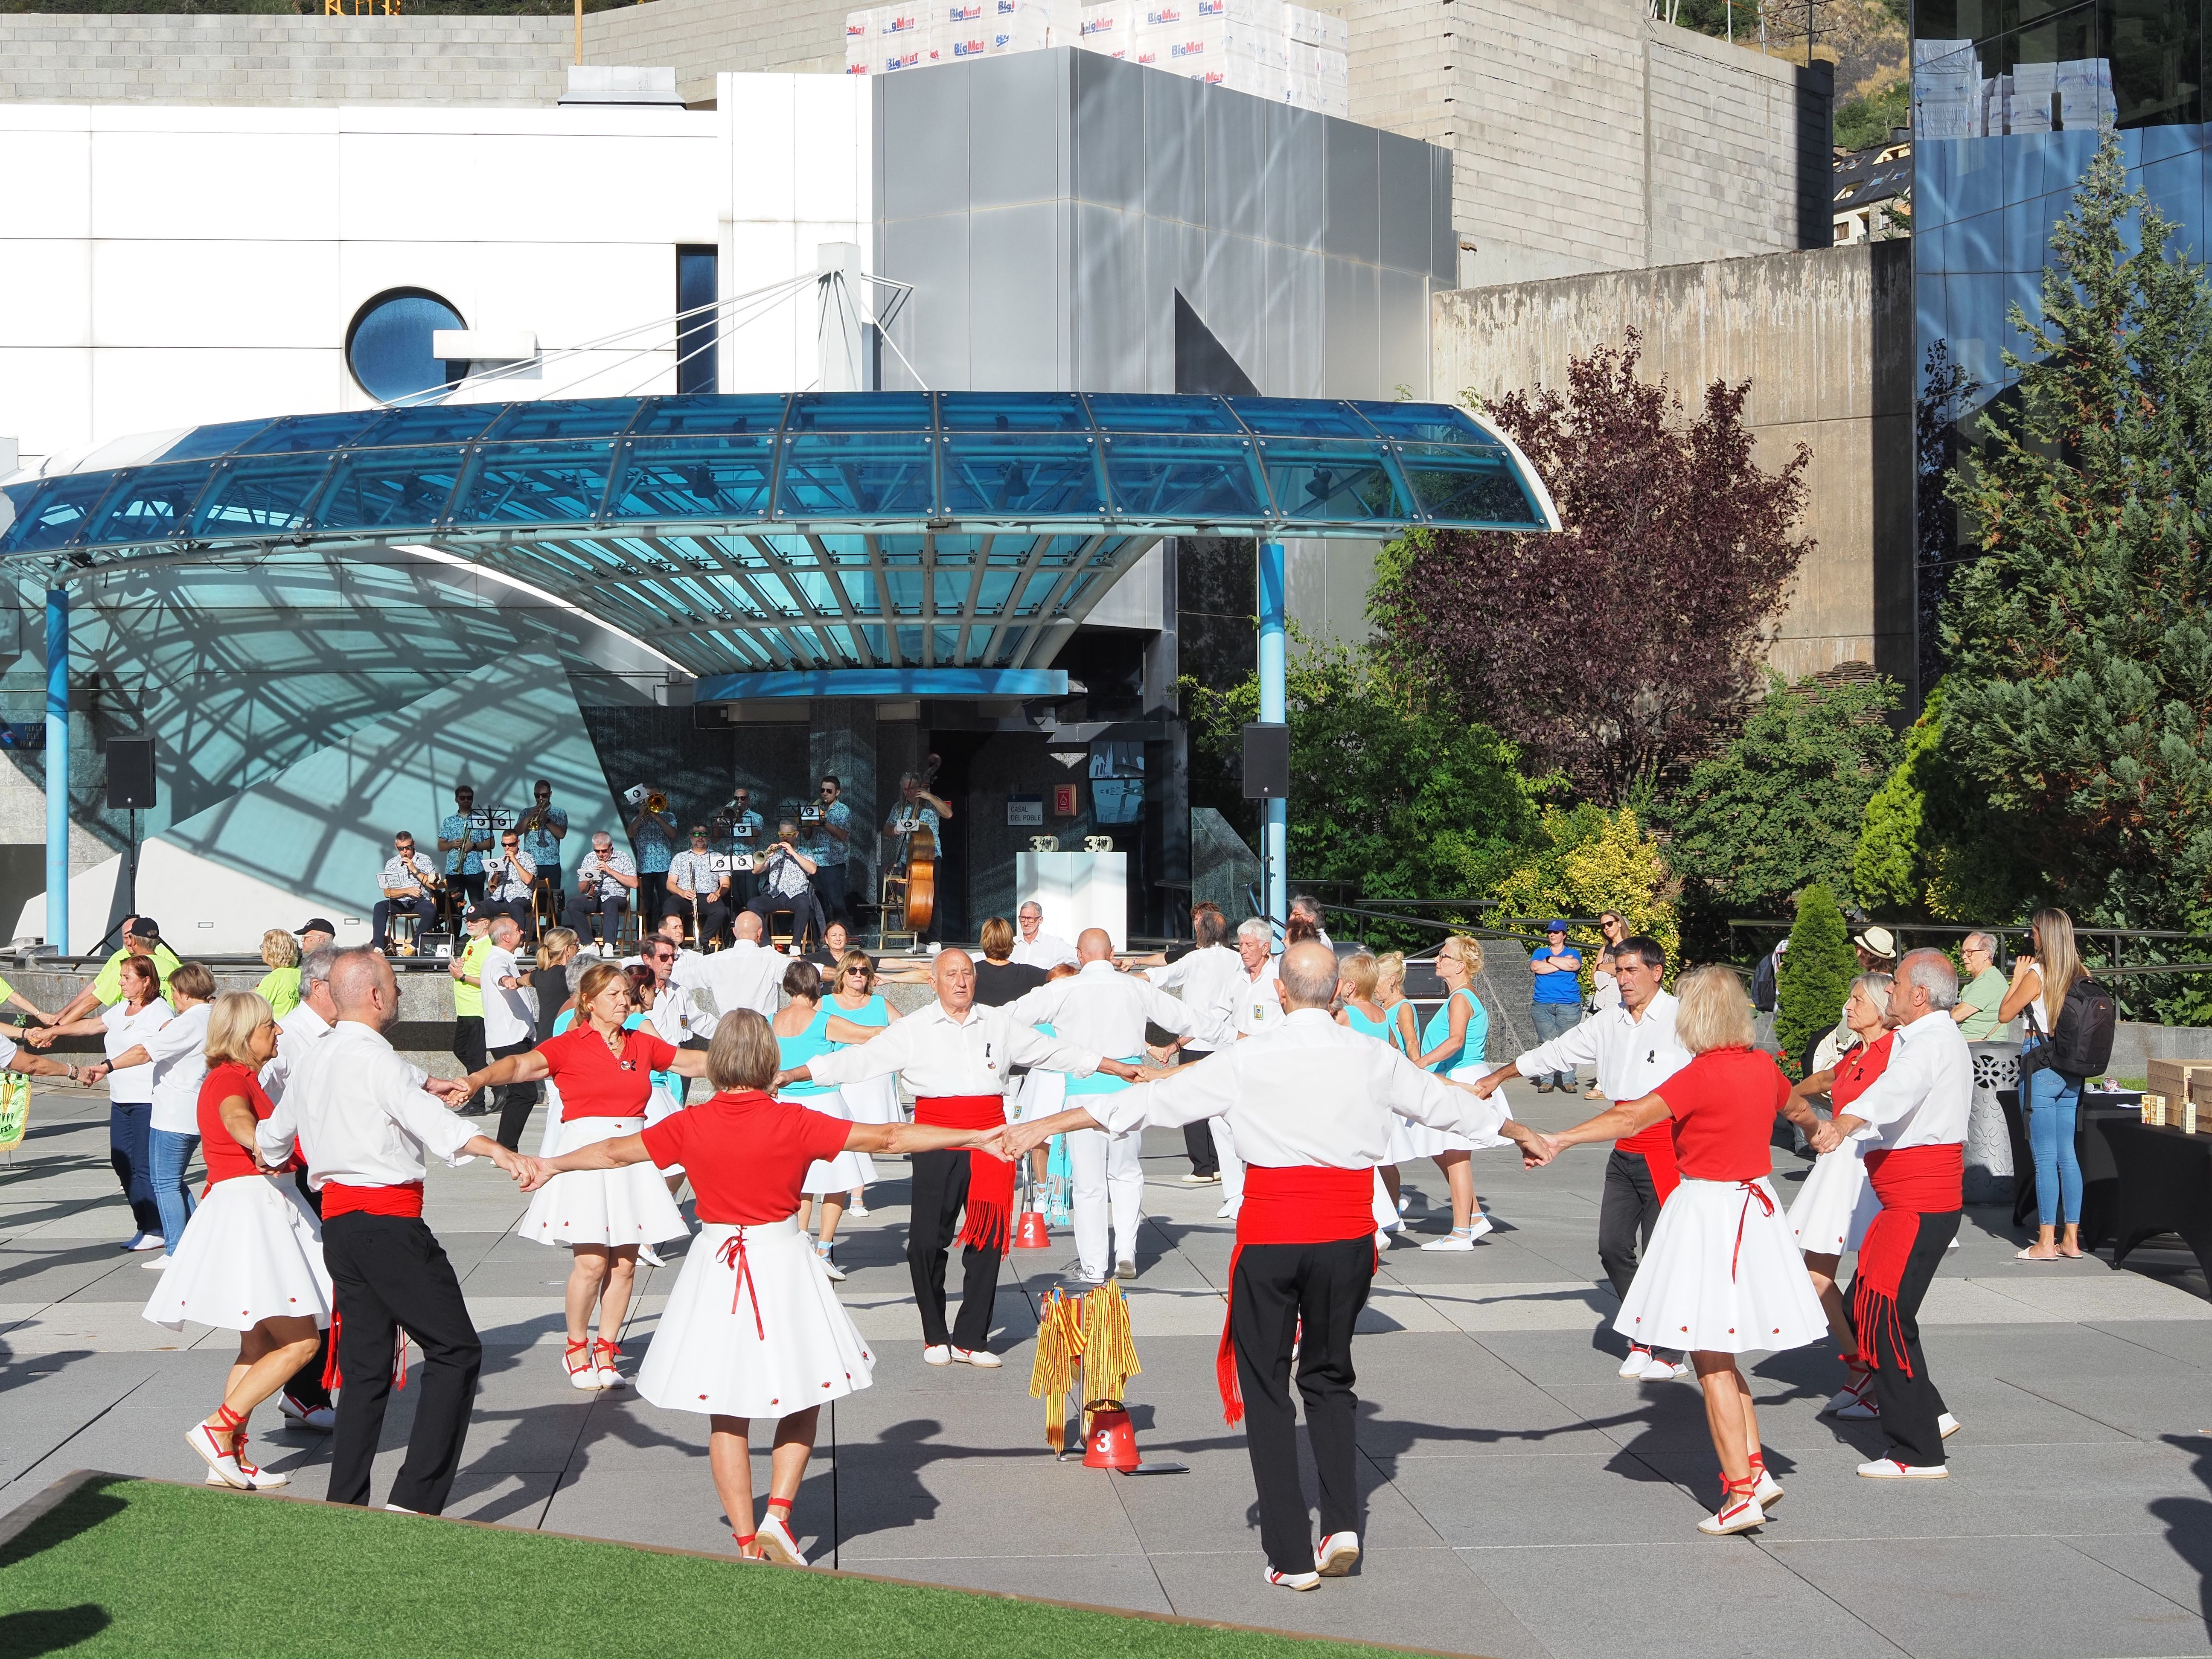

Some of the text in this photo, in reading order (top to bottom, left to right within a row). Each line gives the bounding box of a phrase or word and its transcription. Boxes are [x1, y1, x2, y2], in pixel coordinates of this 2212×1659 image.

[1199, 0, 1223, 15] BigM
[955, 40, 984, 55] BigMat
[1172, 41, 1204, 56] BigMat
[1024, 1223, 1034, 1238] 2
[1096, 1429, 1111, 1452] 3
